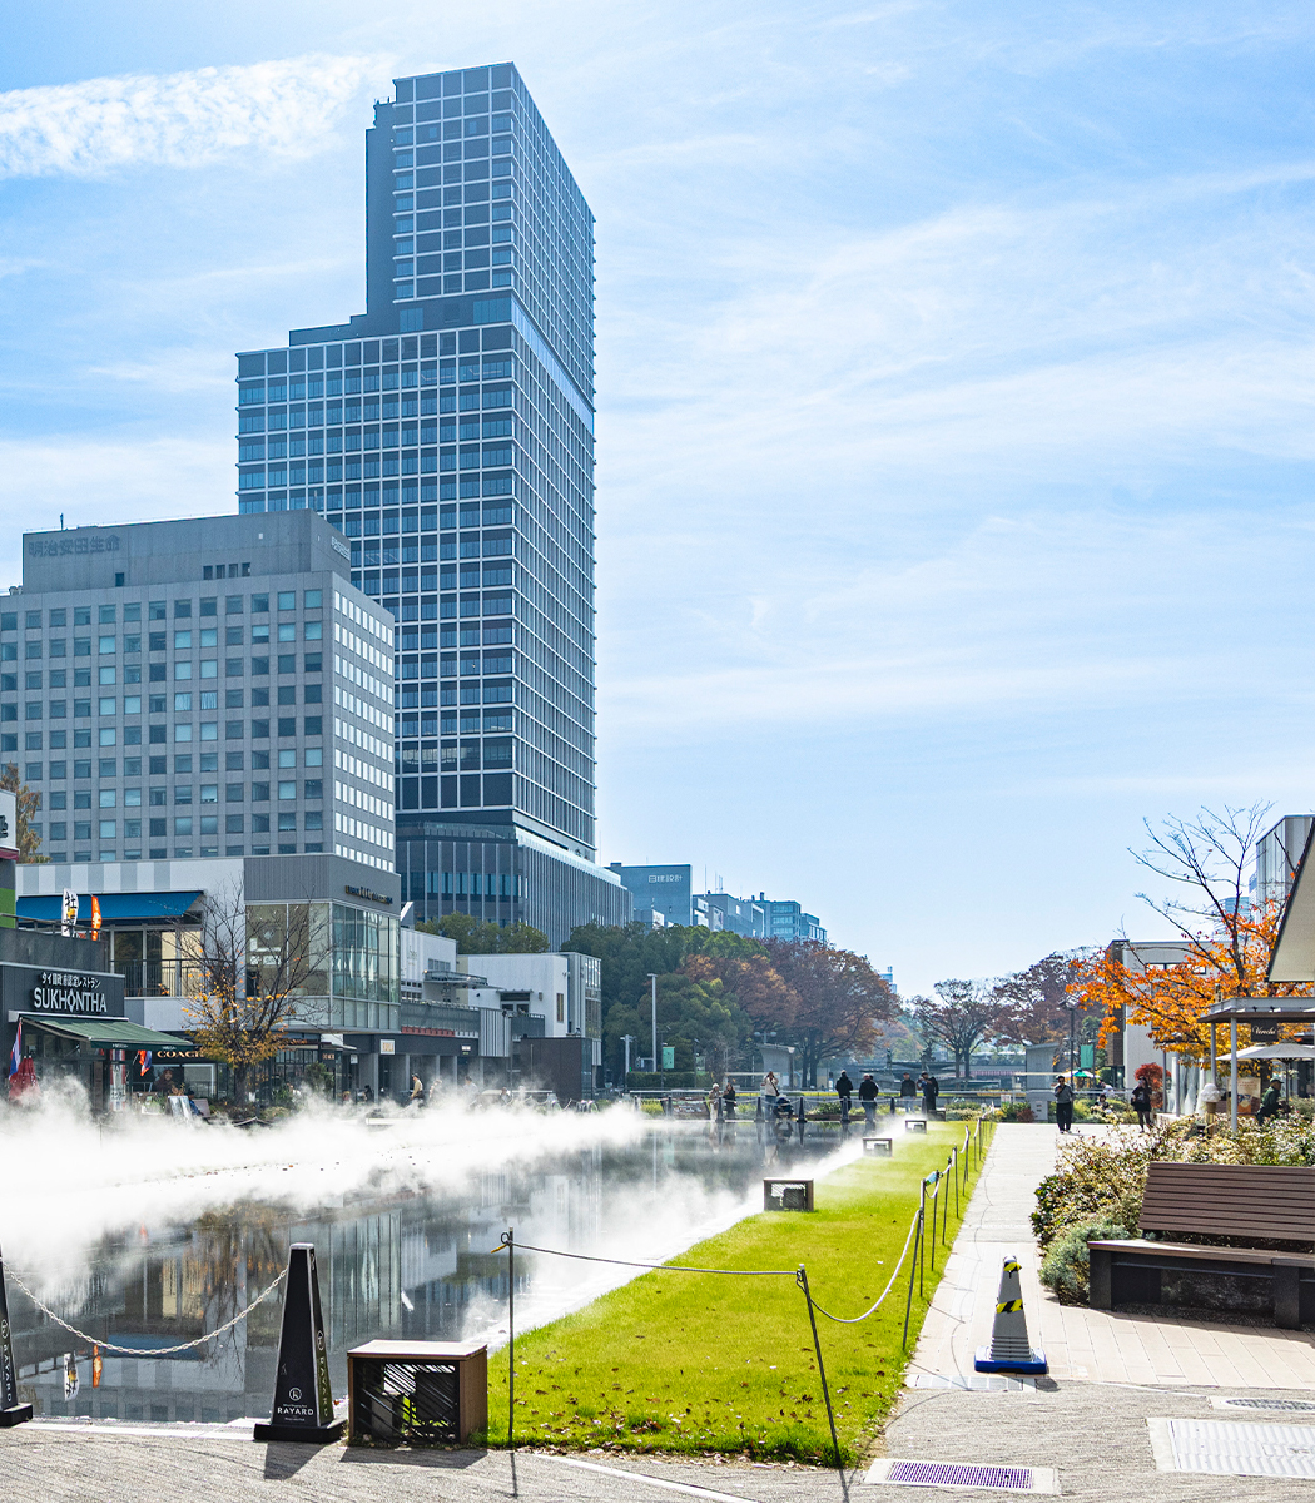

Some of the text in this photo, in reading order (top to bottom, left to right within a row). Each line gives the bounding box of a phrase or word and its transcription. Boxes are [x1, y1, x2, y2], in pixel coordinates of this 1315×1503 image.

[28, 534, 120, 557] 明治安田生命
[34, 987, 107, 1013] SUKHONTHA
[277, 1407, 314, 1416] RAYARD
